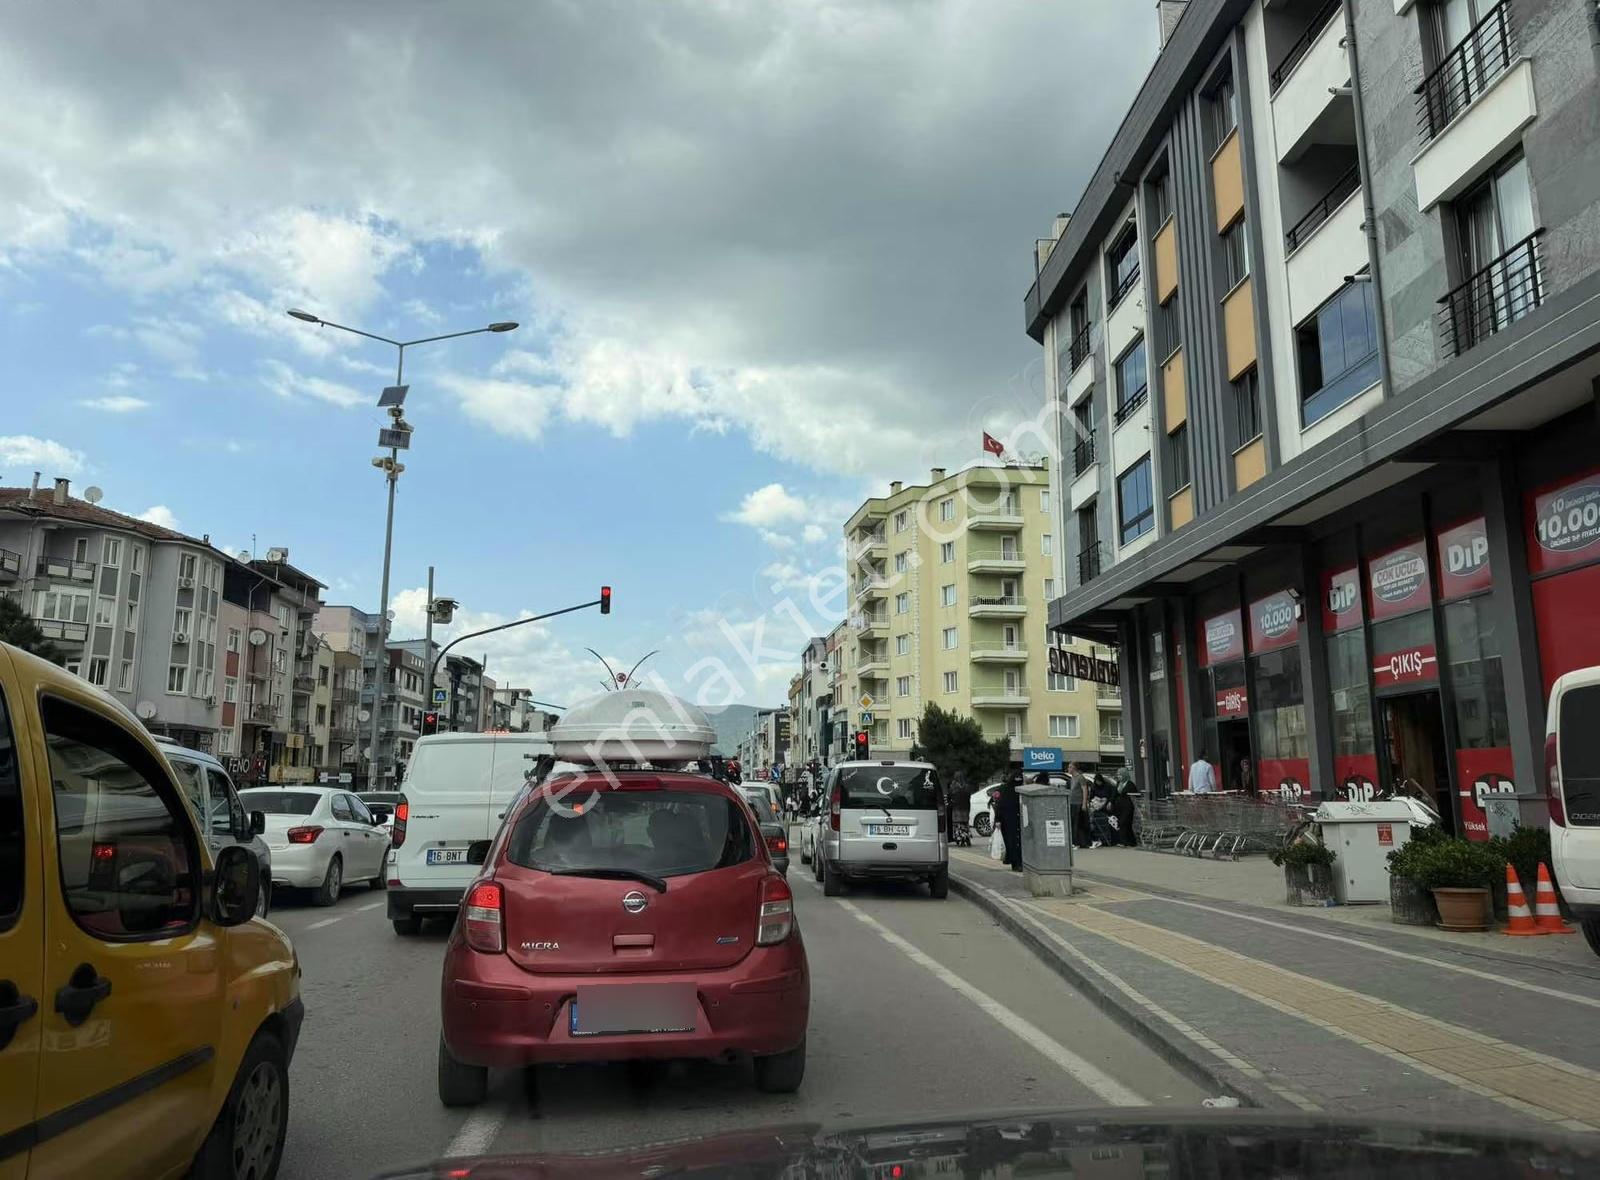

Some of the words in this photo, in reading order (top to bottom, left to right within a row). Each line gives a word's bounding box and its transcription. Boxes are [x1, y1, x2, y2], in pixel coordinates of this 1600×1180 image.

[1552, 499, 1563, 513] 10
[1539, 503, 1600, 540] 10.00
[1261, 606, 1292, 630] 10.000
[1390, 651, 1422, 680] ÇIKIŞ
[1030, 750, 1055, 760] beko
[432, 851, 442, 861] 16
[521, 942, 560, 950] MICRA
